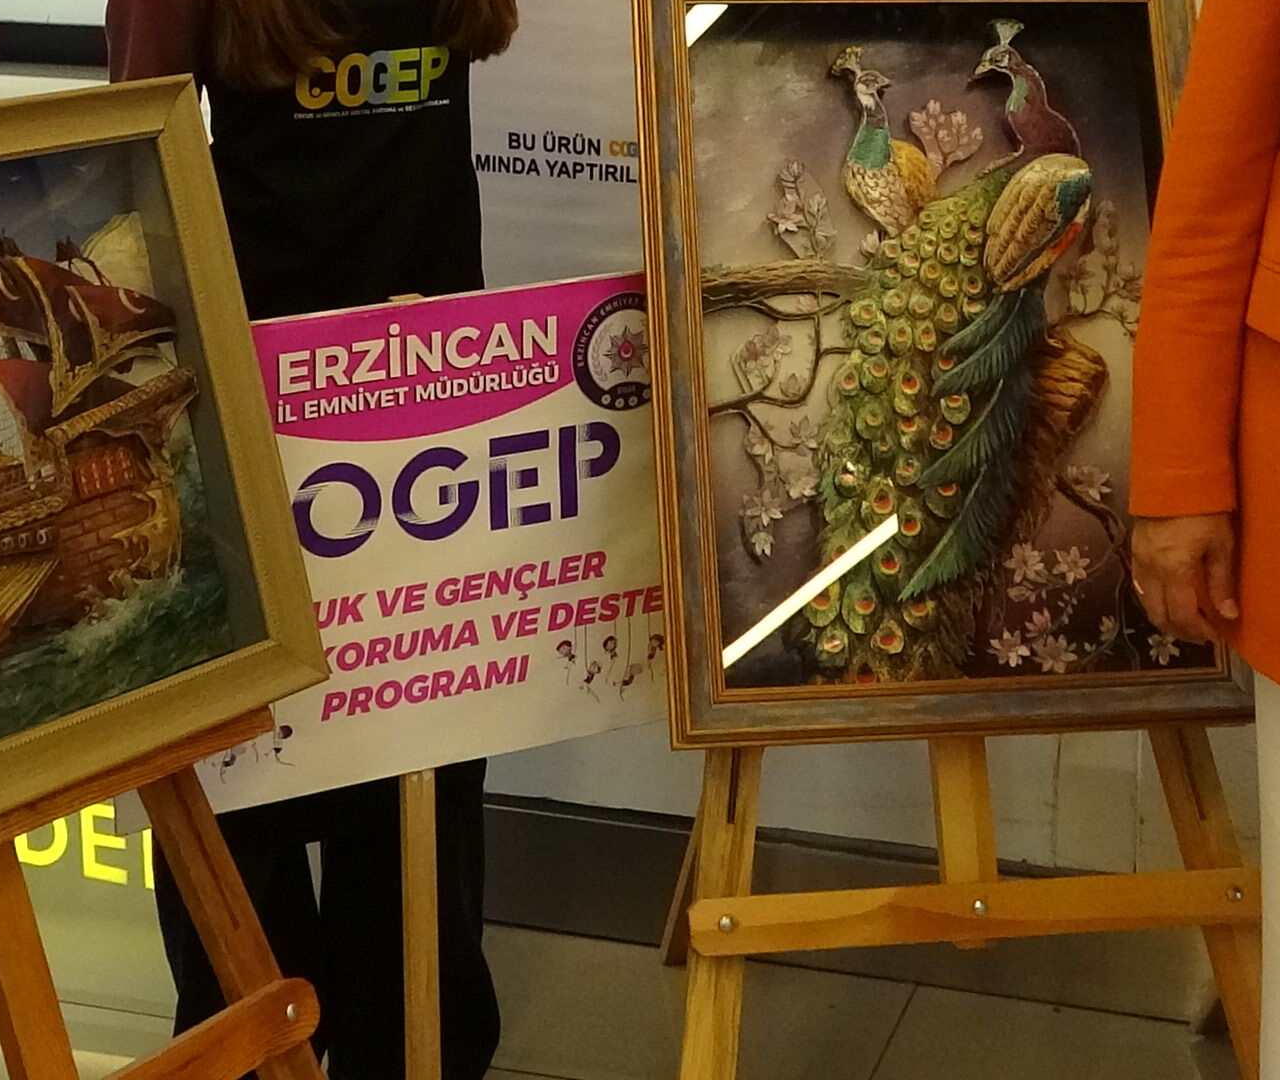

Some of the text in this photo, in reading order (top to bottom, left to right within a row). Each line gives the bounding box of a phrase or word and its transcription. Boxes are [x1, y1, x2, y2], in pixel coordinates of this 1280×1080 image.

[475, 154, 638, 184] MINDA YAPTIRIL
[508, 130, 638, 158] BU ÜRÜN COG
[278, 315, 559, 395] ERZİNCAN
[277, 361, 560, 424] İL EMNİYET MÜDÜRLÜĞÜ
[292, 421, 622, 558] OGEP
[376, 582, 428, 618] VE
[435, 551, 607, 607] GENÇLER
[491, 607, 541, 641] VE
[547, 586, 664, 632] DESTE
[321, 654, 530, 722] PROGRAMI
